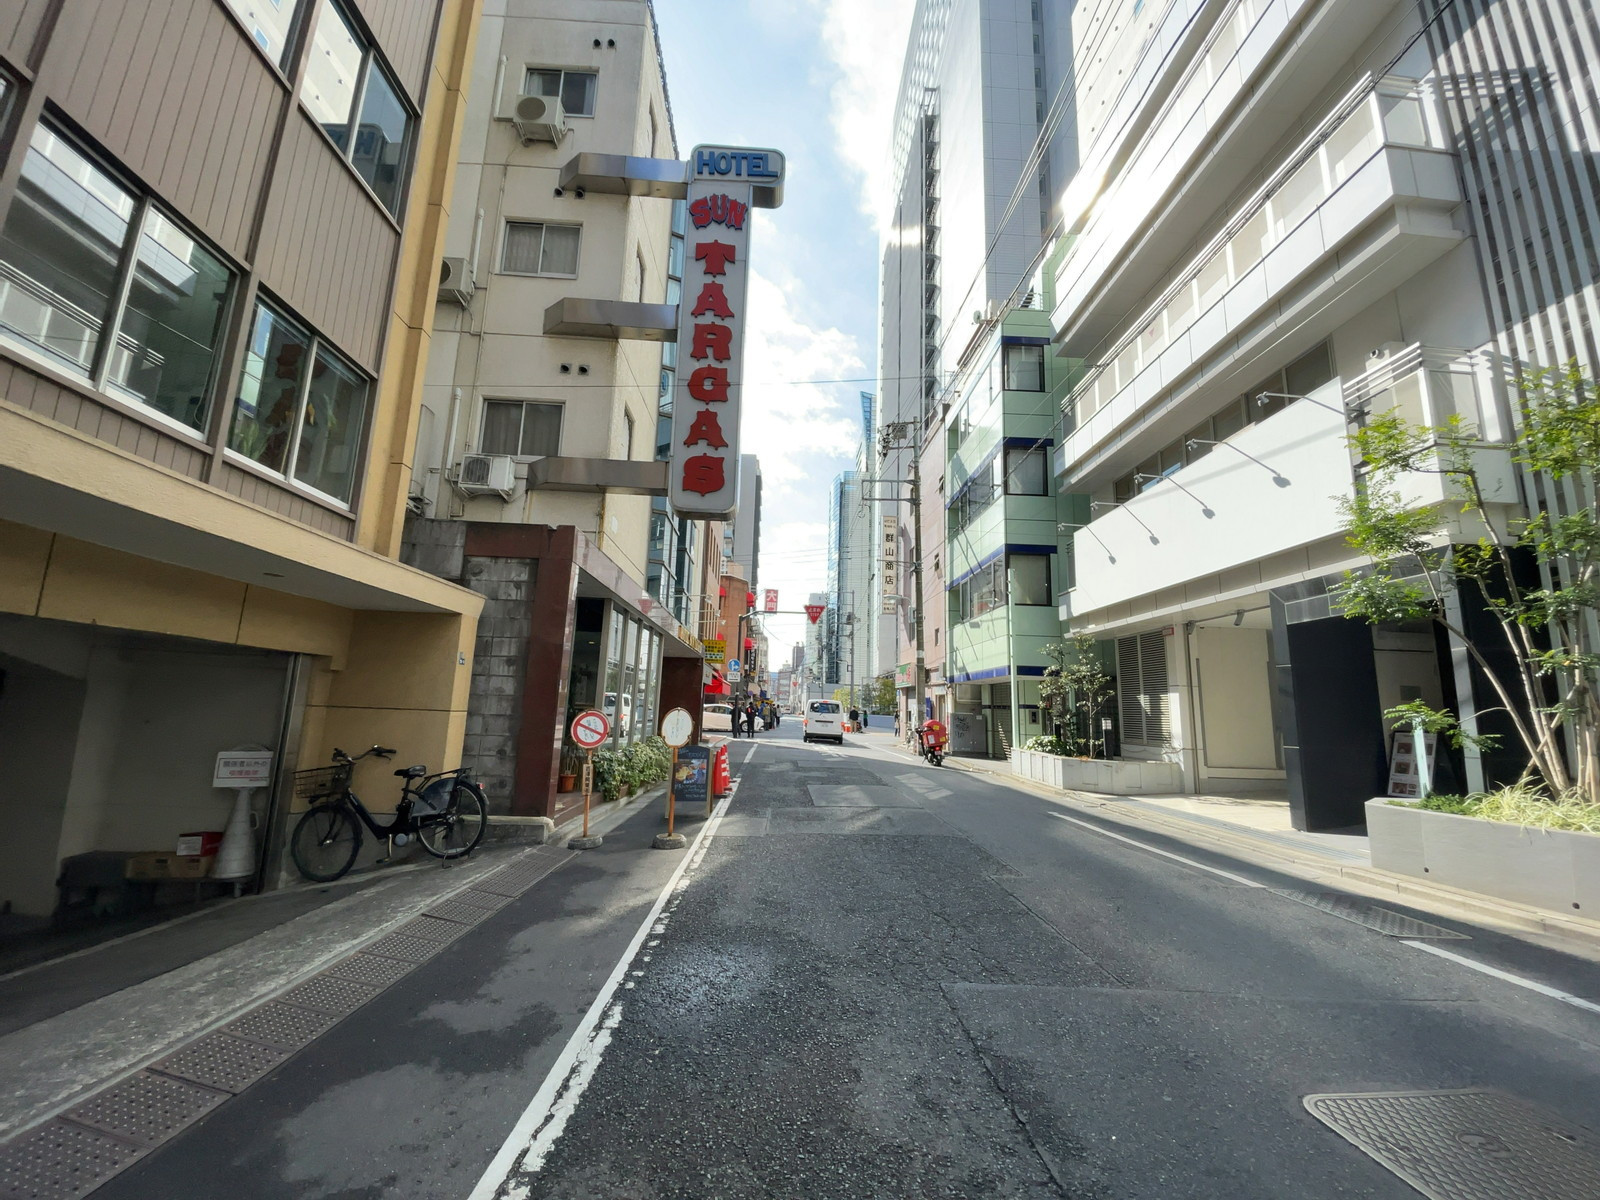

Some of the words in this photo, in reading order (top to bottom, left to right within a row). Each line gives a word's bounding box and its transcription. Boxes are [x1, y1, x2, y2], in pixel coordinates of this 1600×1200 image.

[697, 150, 779, 178] HOTEL
[689, 193, 748, 231] SUN
[682, 239, 736, 496] TARGAS
[885, 533, 894, 585] 群山商店
[766, 590, 777, 611] 大門
